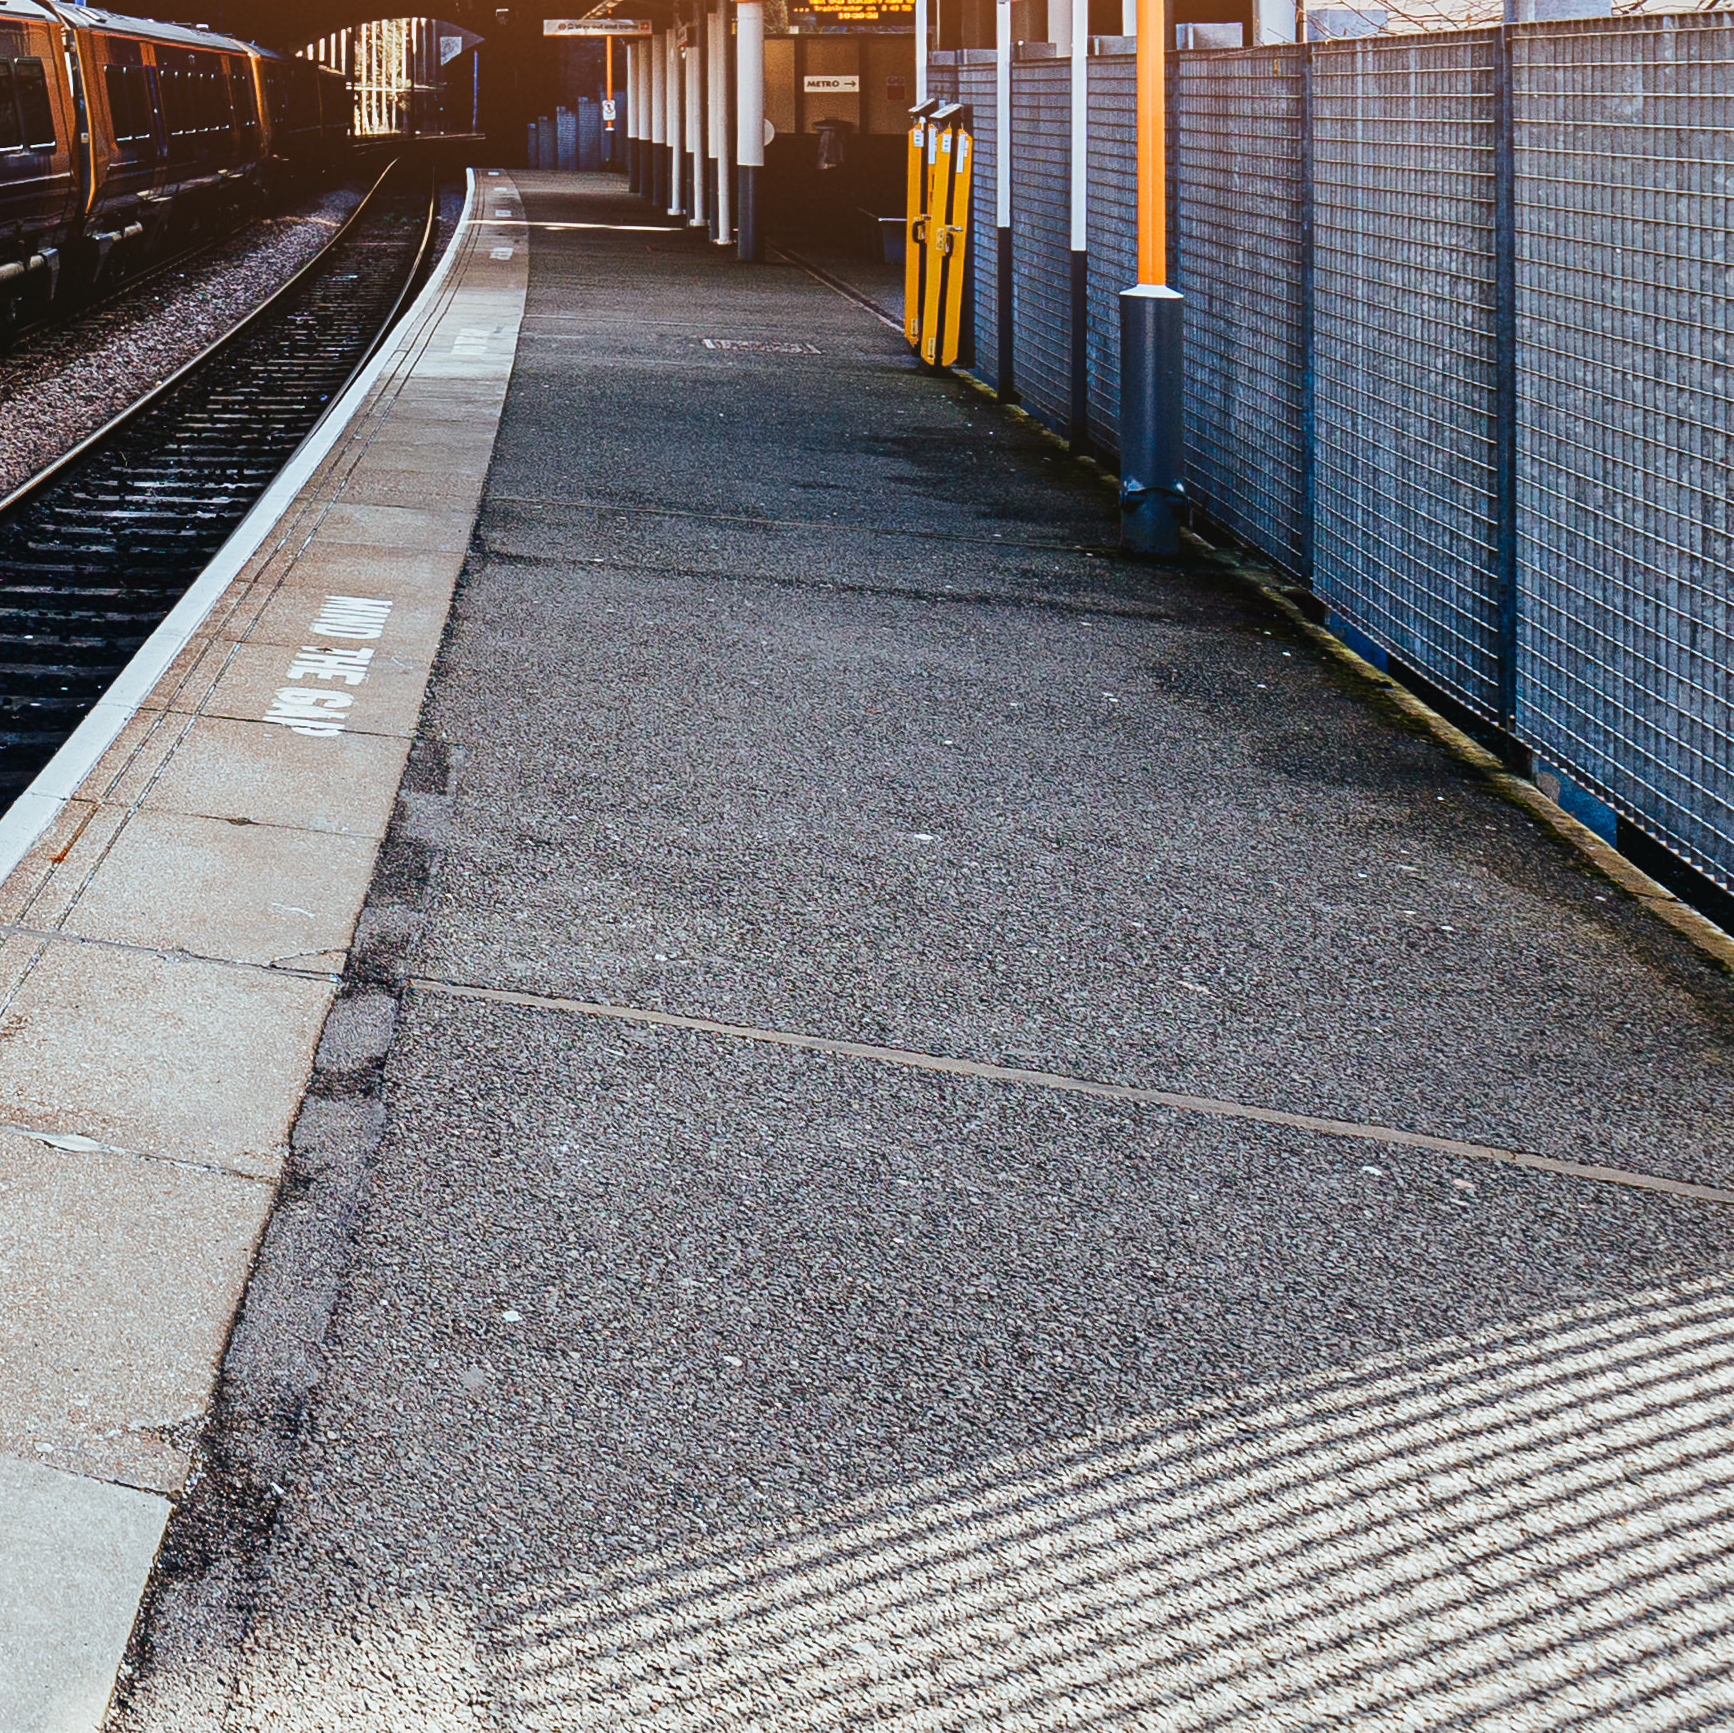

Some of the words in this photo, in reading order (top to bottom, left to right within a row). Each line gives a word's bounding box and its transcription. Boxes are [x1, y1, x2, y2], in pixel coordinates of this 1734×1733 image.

[309, 594, 393, 640] MIND
[286, 645, 375, 686] THE
[262, 687, 355, 738] GAP
